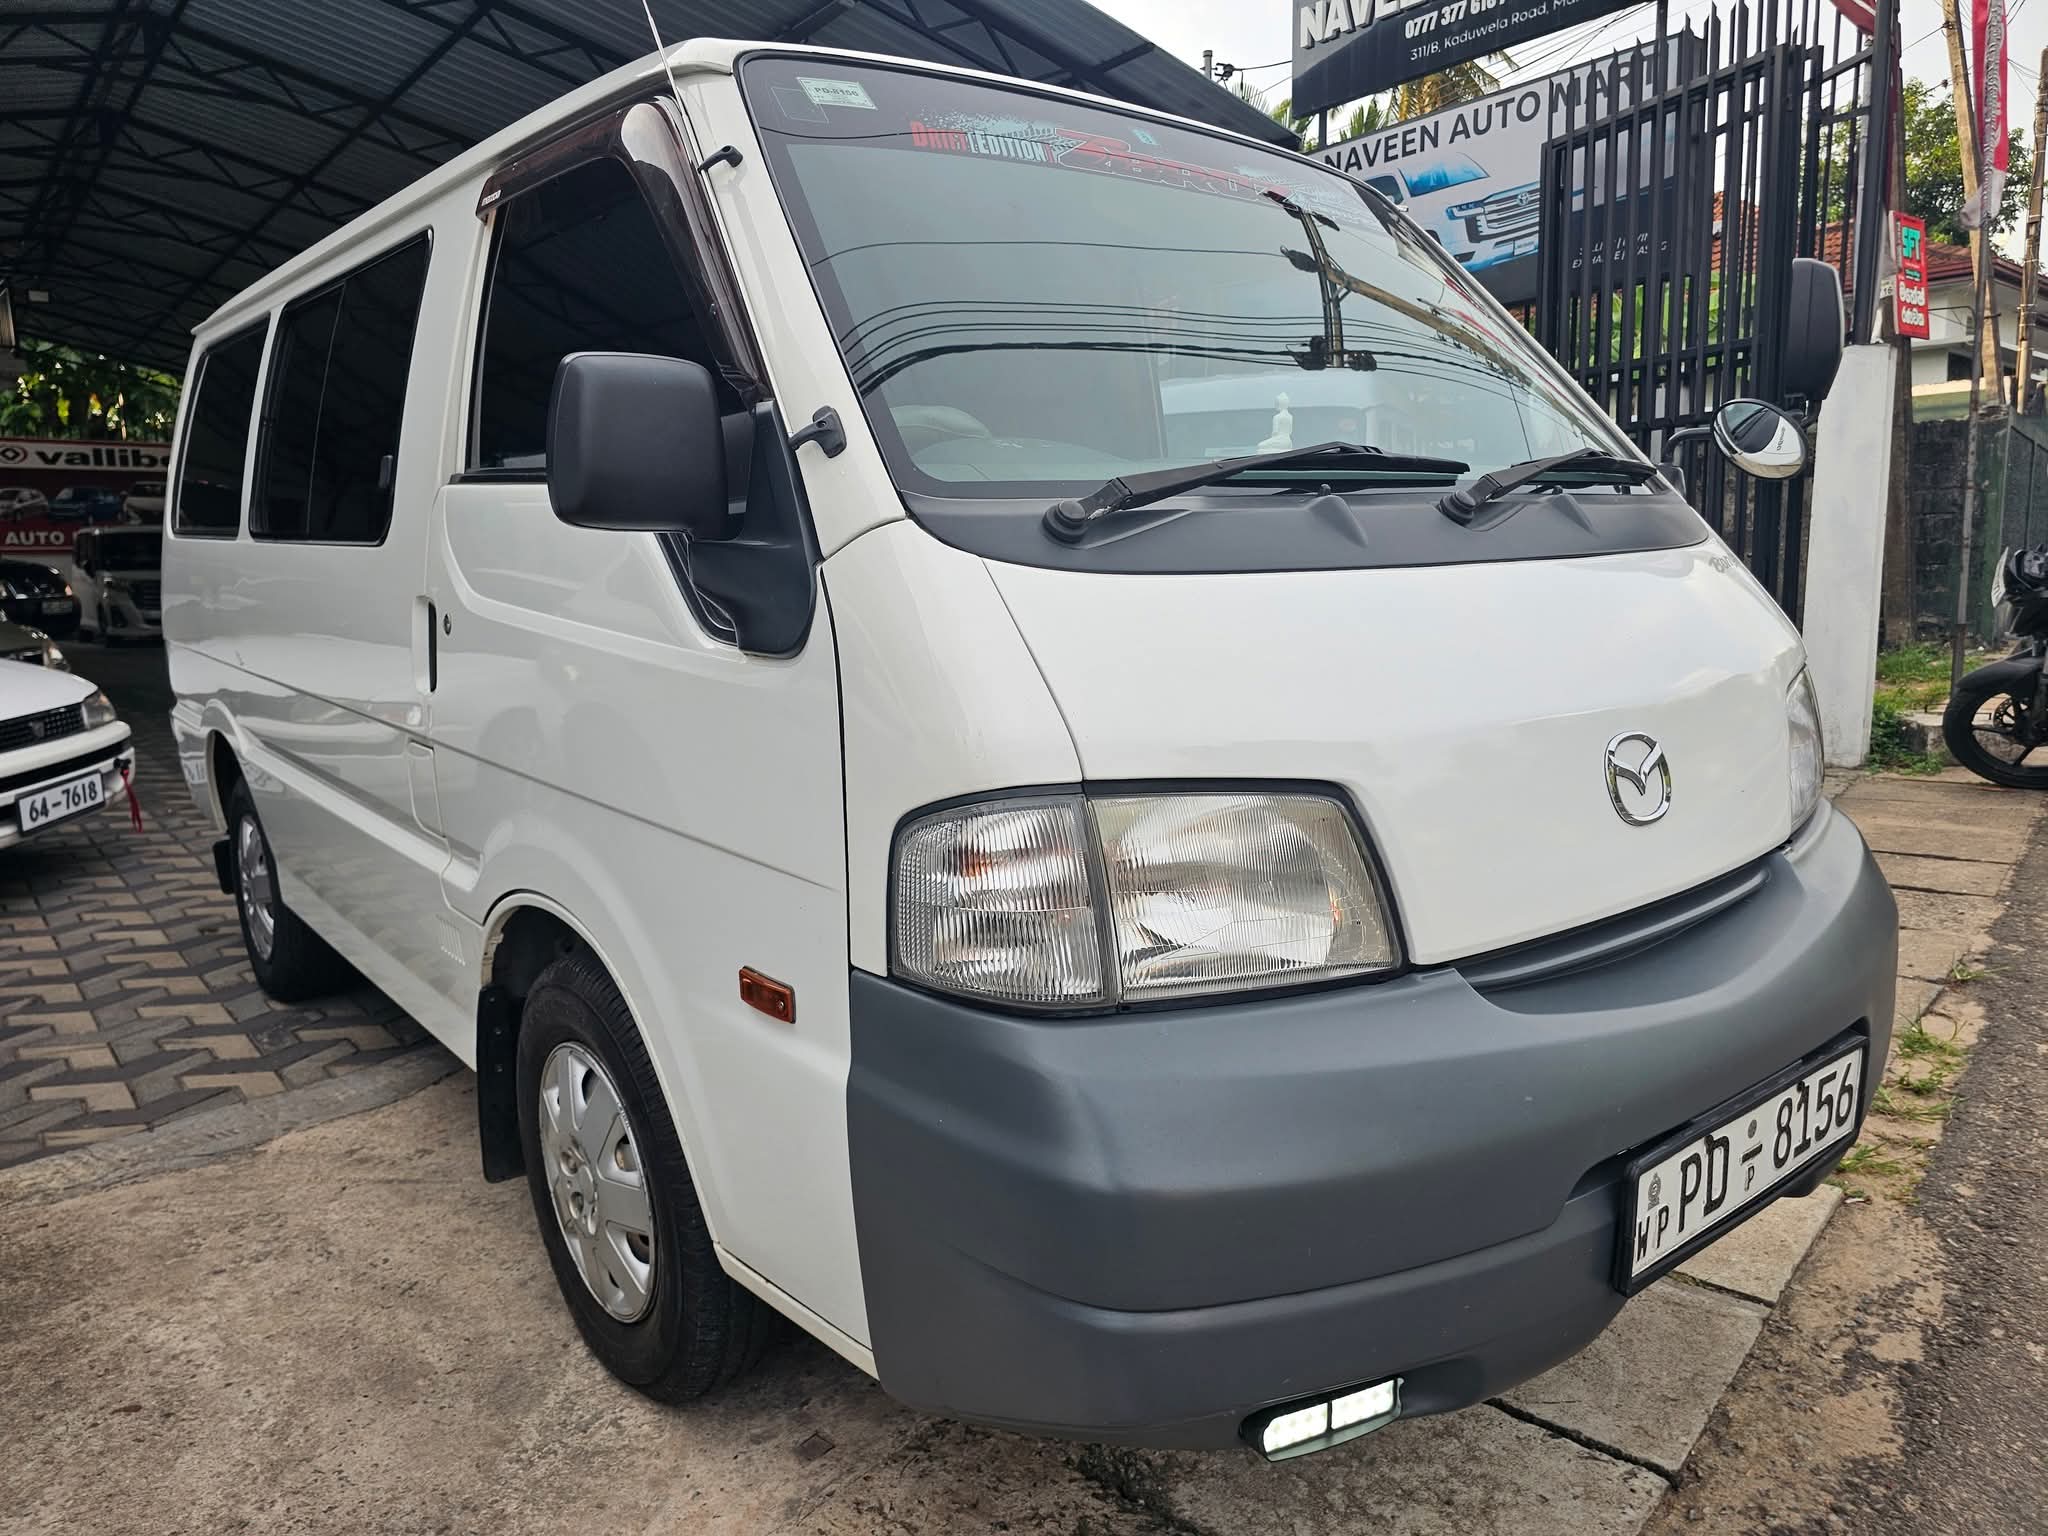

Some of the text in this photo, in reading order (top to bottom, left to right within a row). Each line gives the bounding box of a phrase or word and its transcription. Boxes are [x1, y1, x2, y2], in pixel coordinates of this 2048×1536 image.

[1300, 0, 1428, 48] NAV
[1405, 0, 1506, 39] 0777 377 61
[1444, 18, 1508, 48] Kaduwela
[1511, 2, 1549, 25] Road,
[1323, 120, 1439, 172] NAVEEN
[1449, 91, 1541, 144] AUTO
[5, 531, 65, 545] AUTO
[29, 780, 98, 823] 64-7618
[1677, 1062, 1854, 1233] PD 8156
